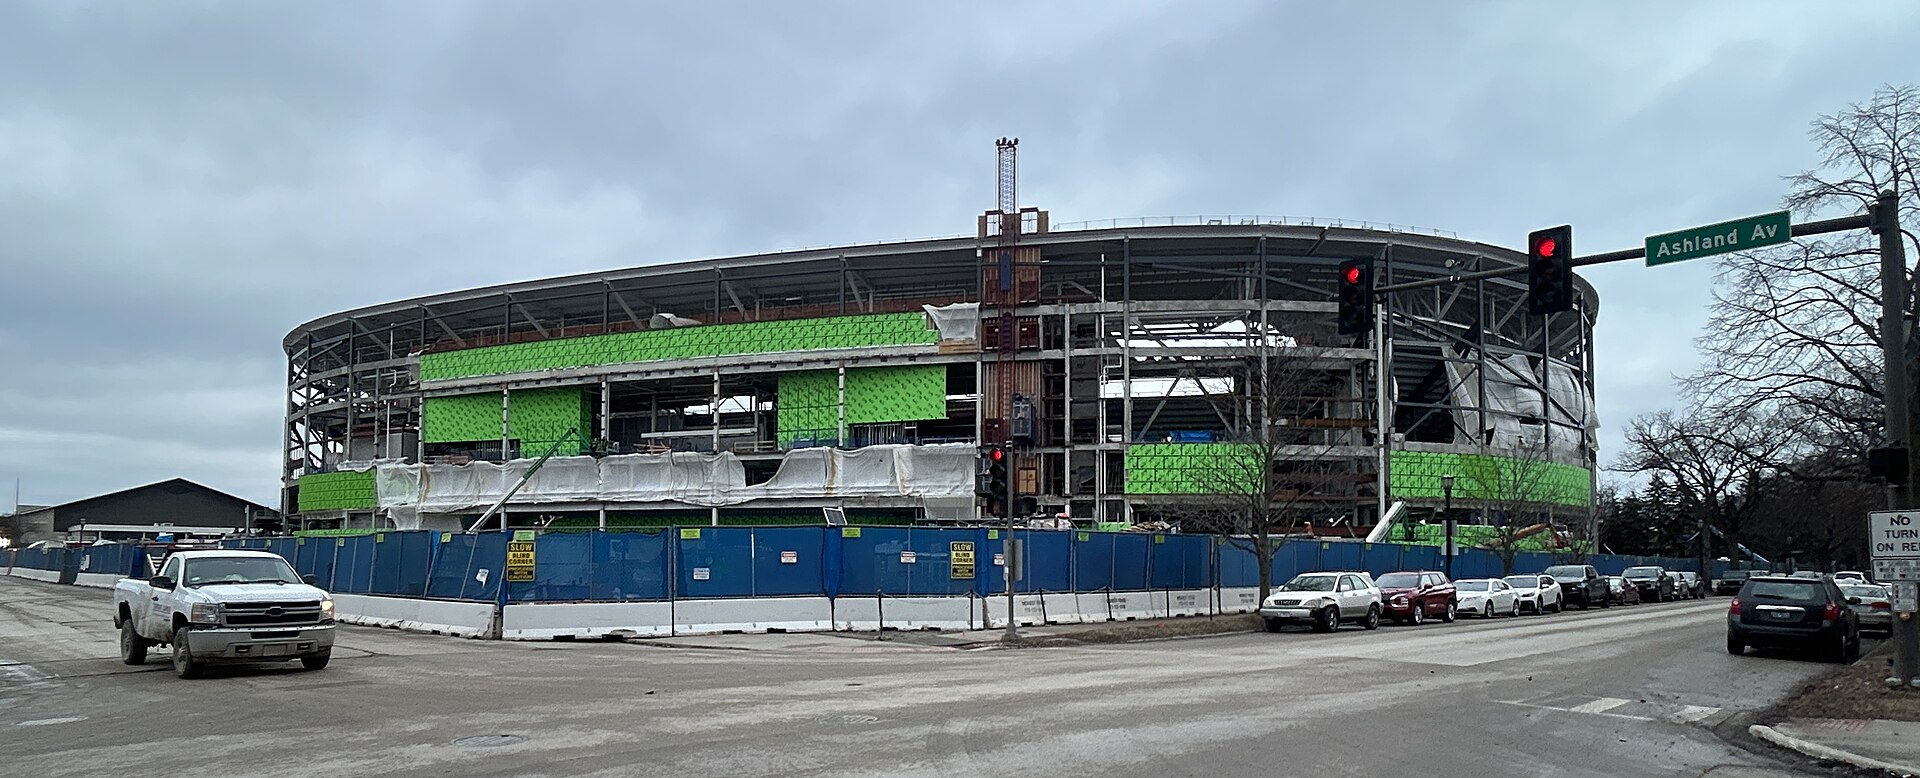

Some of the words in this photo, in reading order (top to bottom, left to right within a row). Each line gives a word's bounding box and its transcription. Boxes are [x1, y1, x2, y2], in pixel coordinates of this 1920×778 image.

[1656, 228, 1738, 258] Ashland
[1750, 223, 1778, 241] Av
[1890, 515, 1910, 526] NO
[1884, 529, 1918, 539] TURN
[510, 543, 533, 551] SLOW
[953, 543, 972, 551] SLOW
[1876, 542, 1894, 552] ON
[1902, 542, 1920, 552] RE
